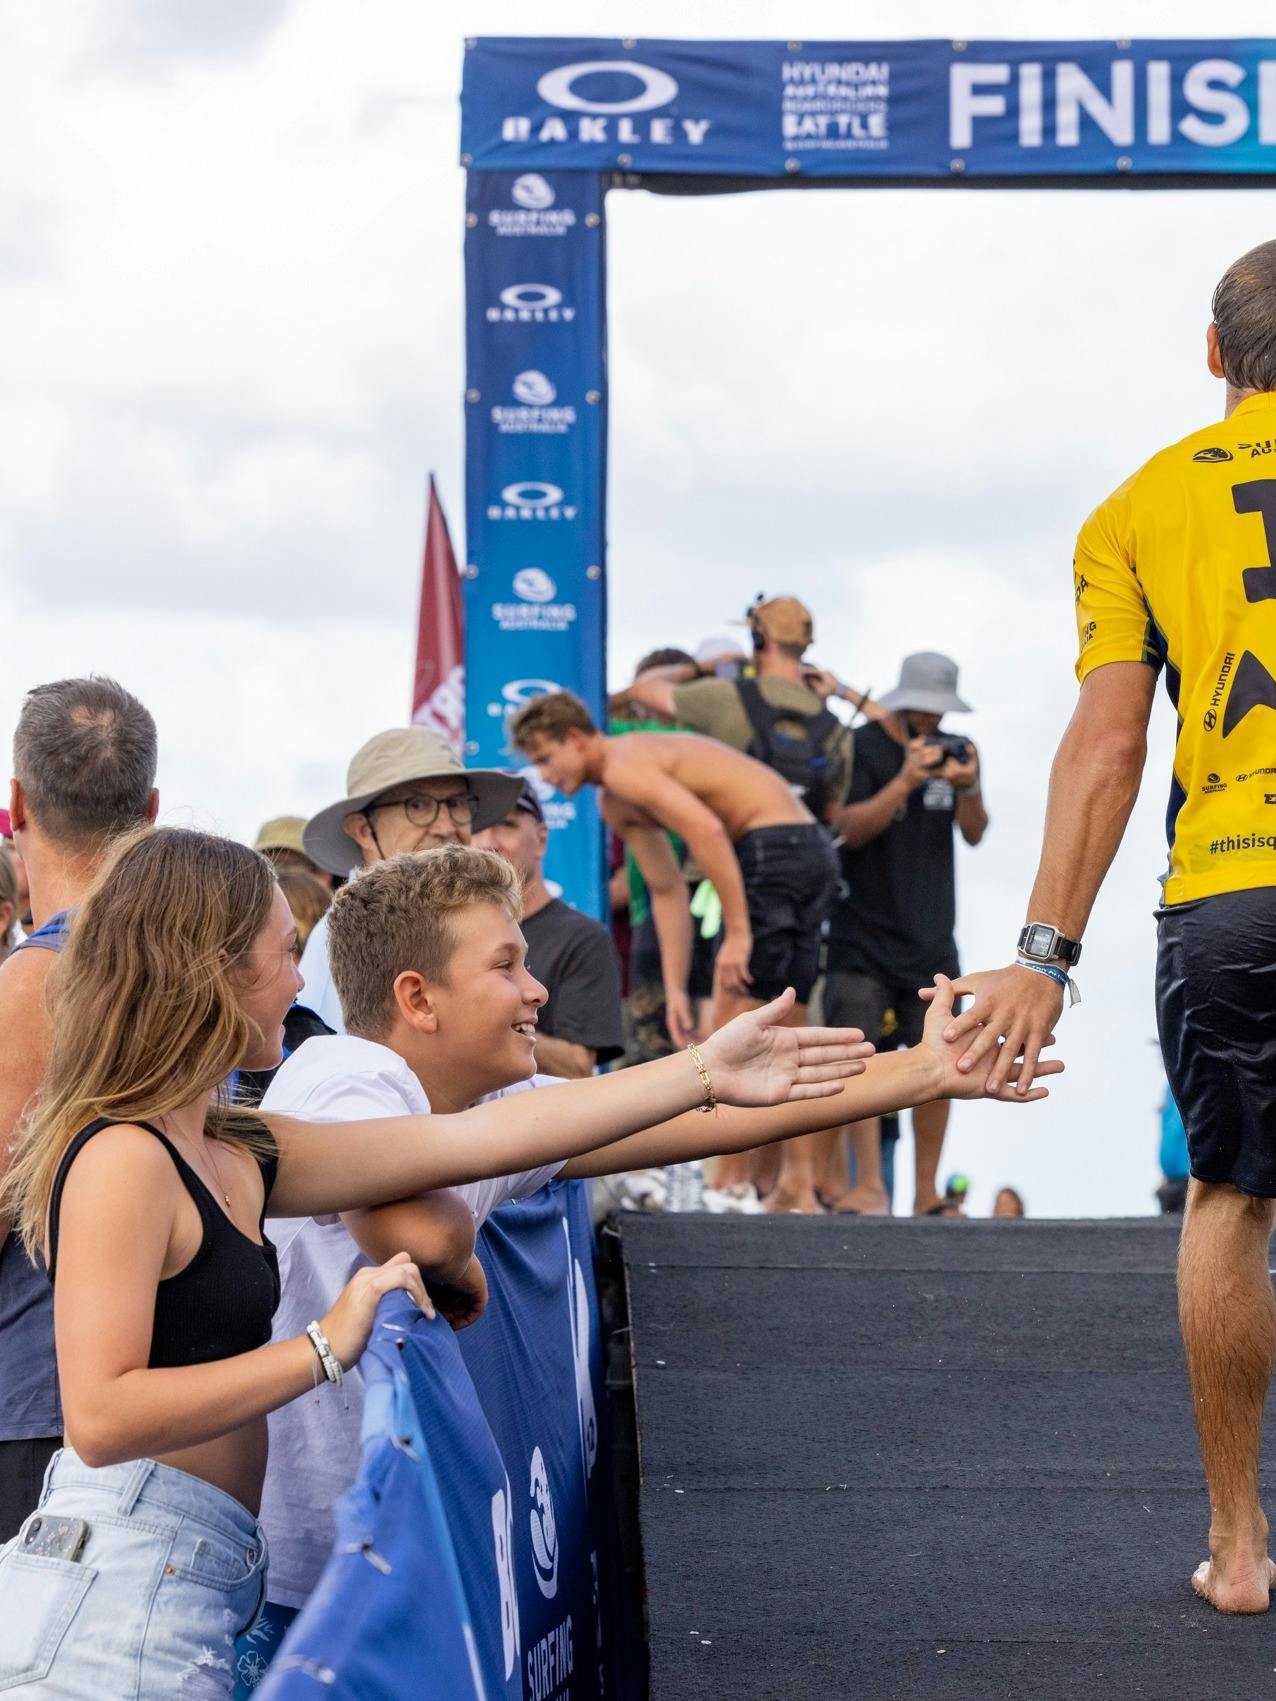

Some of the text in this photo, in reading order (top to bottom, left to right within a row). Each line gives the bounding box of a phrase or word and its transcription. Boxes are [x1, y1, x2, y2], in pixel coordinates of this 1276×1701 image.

[782, 61, 889, 83] HYUNDAI
[501, 115, 712, 146] OAKLEY
[782, 113, 888, 139] BATTLE
[488, 208, 576, 227] SURFING
[486, 307, 576, 323] OAKLEY
[491, 405, 577, 424] SURFING
[487, 504, 578, 521] OAKLEY
[491, 602, 577, 622] SURFING
[1210, 652, 1236, 707] HYUNDAI
[1201, 783, 1228, 792] SURFING
[527, 1613, 574, 1701] SURFING
